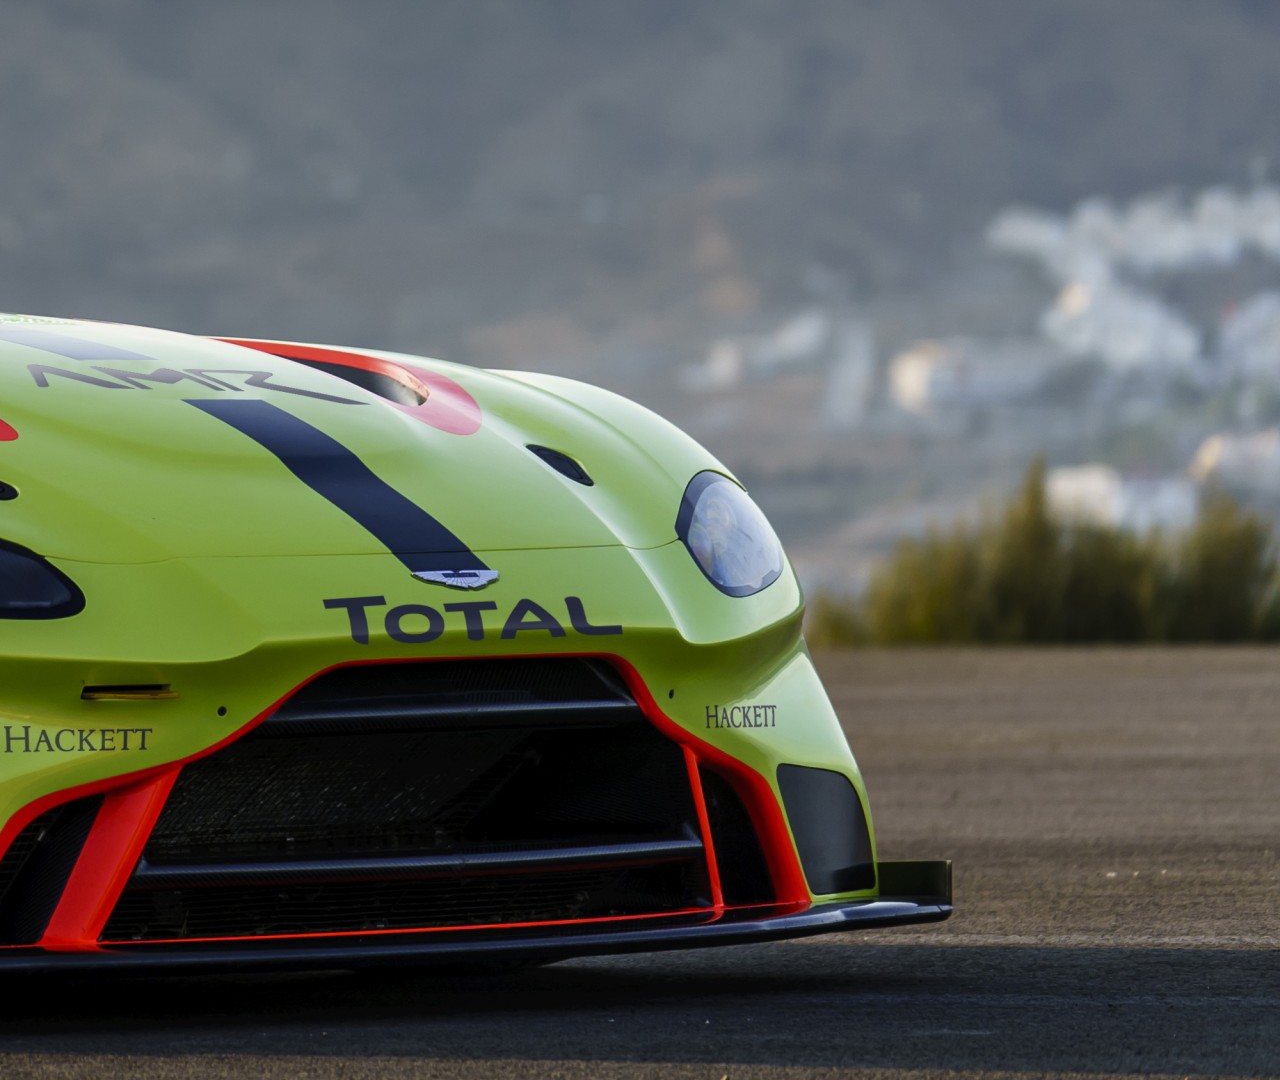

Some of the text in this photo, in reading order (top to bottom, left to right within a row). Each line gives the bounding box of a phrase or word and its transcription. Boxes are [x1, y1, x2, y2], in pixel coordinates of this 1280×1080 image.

[323, 595, 623, 645] TOTAL
[704, 704, 778, 729] HACKETT
[3, 725, 153, 753] HACKETT
